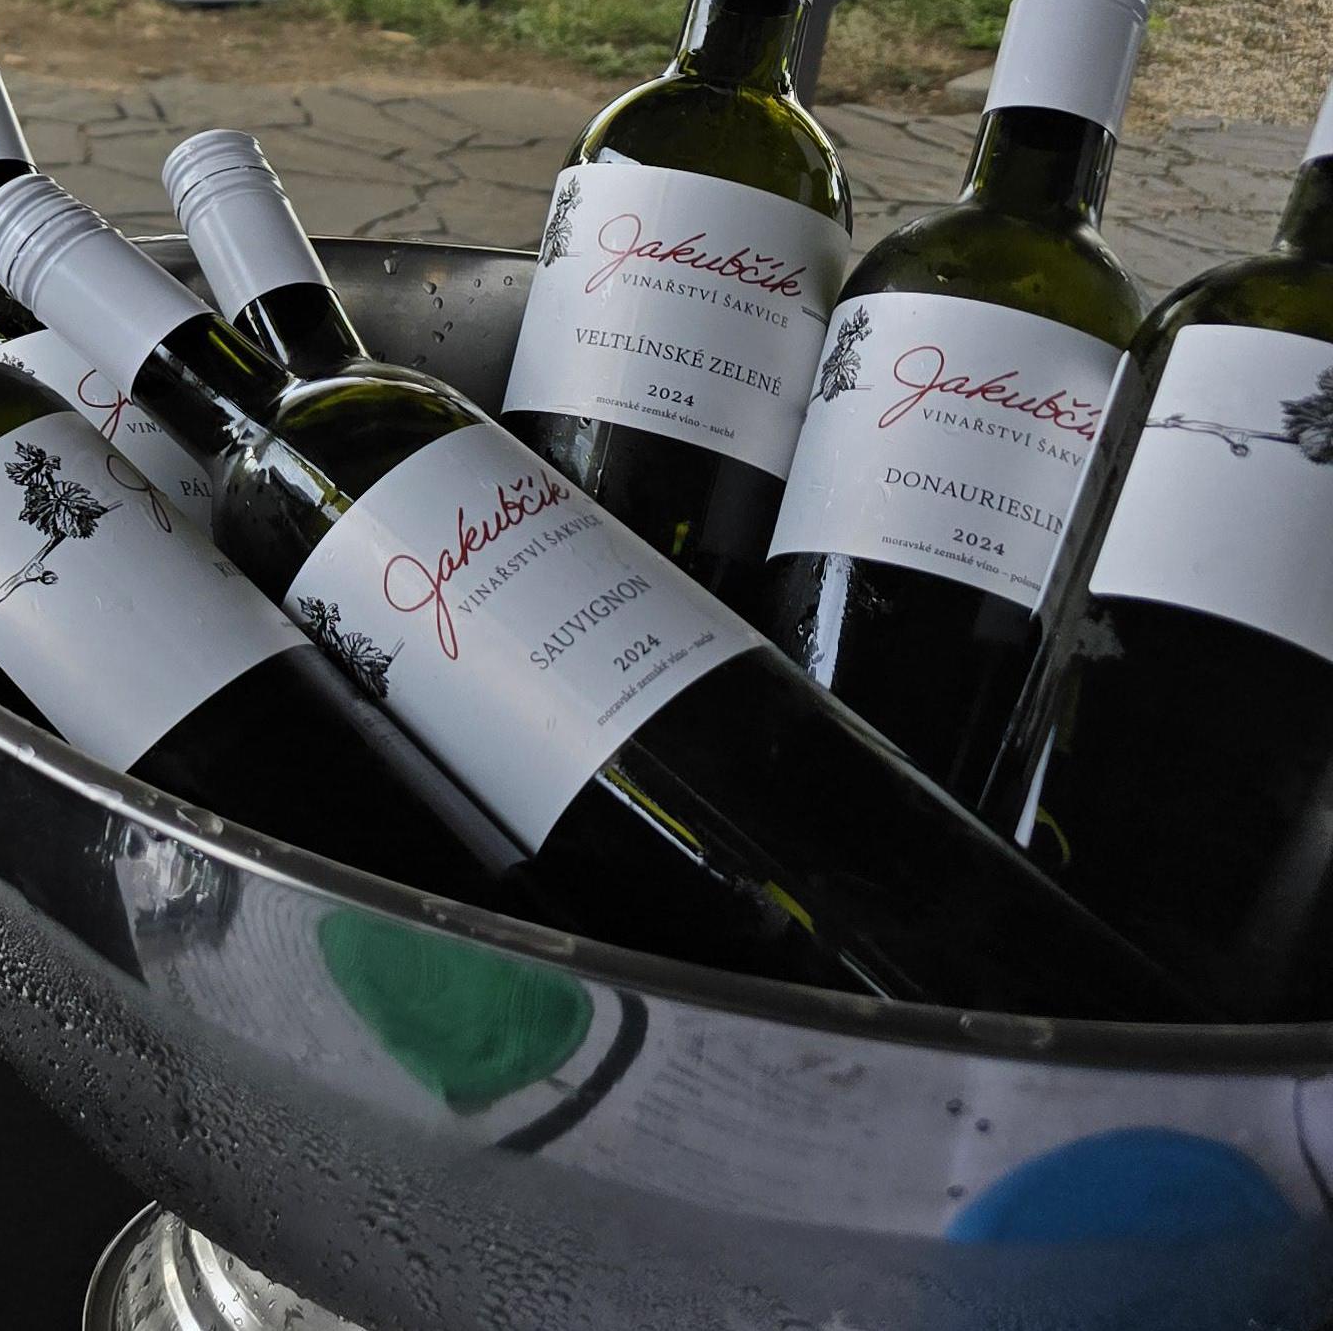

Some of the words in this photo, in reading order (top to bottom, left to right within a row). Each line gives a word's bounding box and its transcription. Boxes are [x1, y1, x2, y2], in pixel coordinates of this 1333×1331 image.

[585, 213, 807, 297] Jakubčík
[621, 272, 718, 304] VINAŘSTVÍ
[723, 294, 790, 329] ŠAKVICE
[575, 327, 705, 370] VELTLÍNSKÉ
[708, 355, 782, 397] ZELENÉ
[878, 346, 1102, 442] Jakubčí
[595, 394, 640, 412] moravské
[641, 404, 678, 421] zemské
[678, 414, 701, 428] víno
[709, 423, 736, 439] suché
[647, 384, 695, 407] 2024
[922, 408, 1032, 448] VINAŘSTVÍ
[1036, 436, 1085, 468] ŠAKV
[180, 478, 214, 499] PÁL
[884, 467, 1064, 536] DONAURIESLIN
[383, 469, 570, 661] Jakubčík
[458, 540, 548, 615] VINAŘSTVÍ
[544, 513, 603, 547] ŠAKVICE
[881, 535, 932, 554] moravské
[933, 547, 974, 567] zemské
[975, 560, 1000, 574] víno
[952, 527, 1005, 556] 2024
[529, 573, 653, 671] SAUVIGNON
[613, 633, 661, 672] 2024
[596, 683, 638, 727] moravské
[636, 658, 669, 691] zemské
